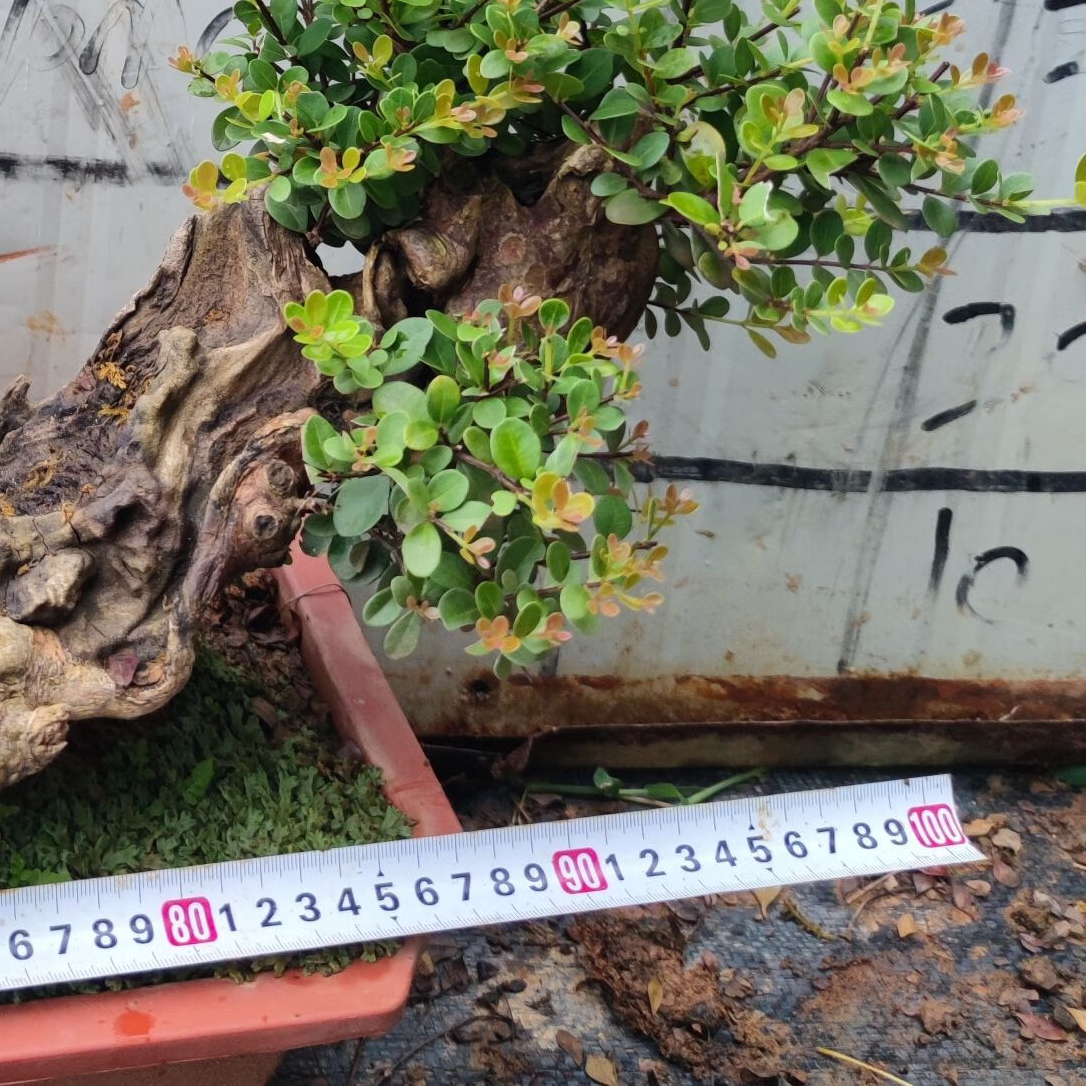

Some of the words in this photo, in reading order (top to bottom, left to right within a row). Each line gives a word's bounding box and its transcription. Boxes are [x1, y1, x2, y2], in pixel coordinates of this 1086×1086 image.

[8, 929, 34, 960] 6
[49, 923, 72, 955] 7
[91, 918, 118, 949] 8
[128, 913, 155, 944] 9
[167, 901, 212, 945] 80
[218, 902, 238, 932] 1
[255, 897, 283, 928] 2
[295, 892, 322, 922] 3
[337, 887, 362, 916] 4
[374, 881, 400, 912] 5
[414, 876, 440, 906] 6
[450, 871, 471, 901] 7
[489, 867, 516, 896] 8
[523, 862, 549, 892] 9
[557, 851, 603, 893] 90
[604, 853, 625, 881] 1
[639, 848, 666, 877] 2
[674, 843, 702, 873] 3
[715, 839, 738, 867] 4
[746, 835, 773, 863] 5
[783, 830, 809, 859] 6
[816, 826, 836, 854] 7
[852, 821, 879, 850] 8
[882, 817, 909, 846] 9
[909, 806, 965, 846] 100
